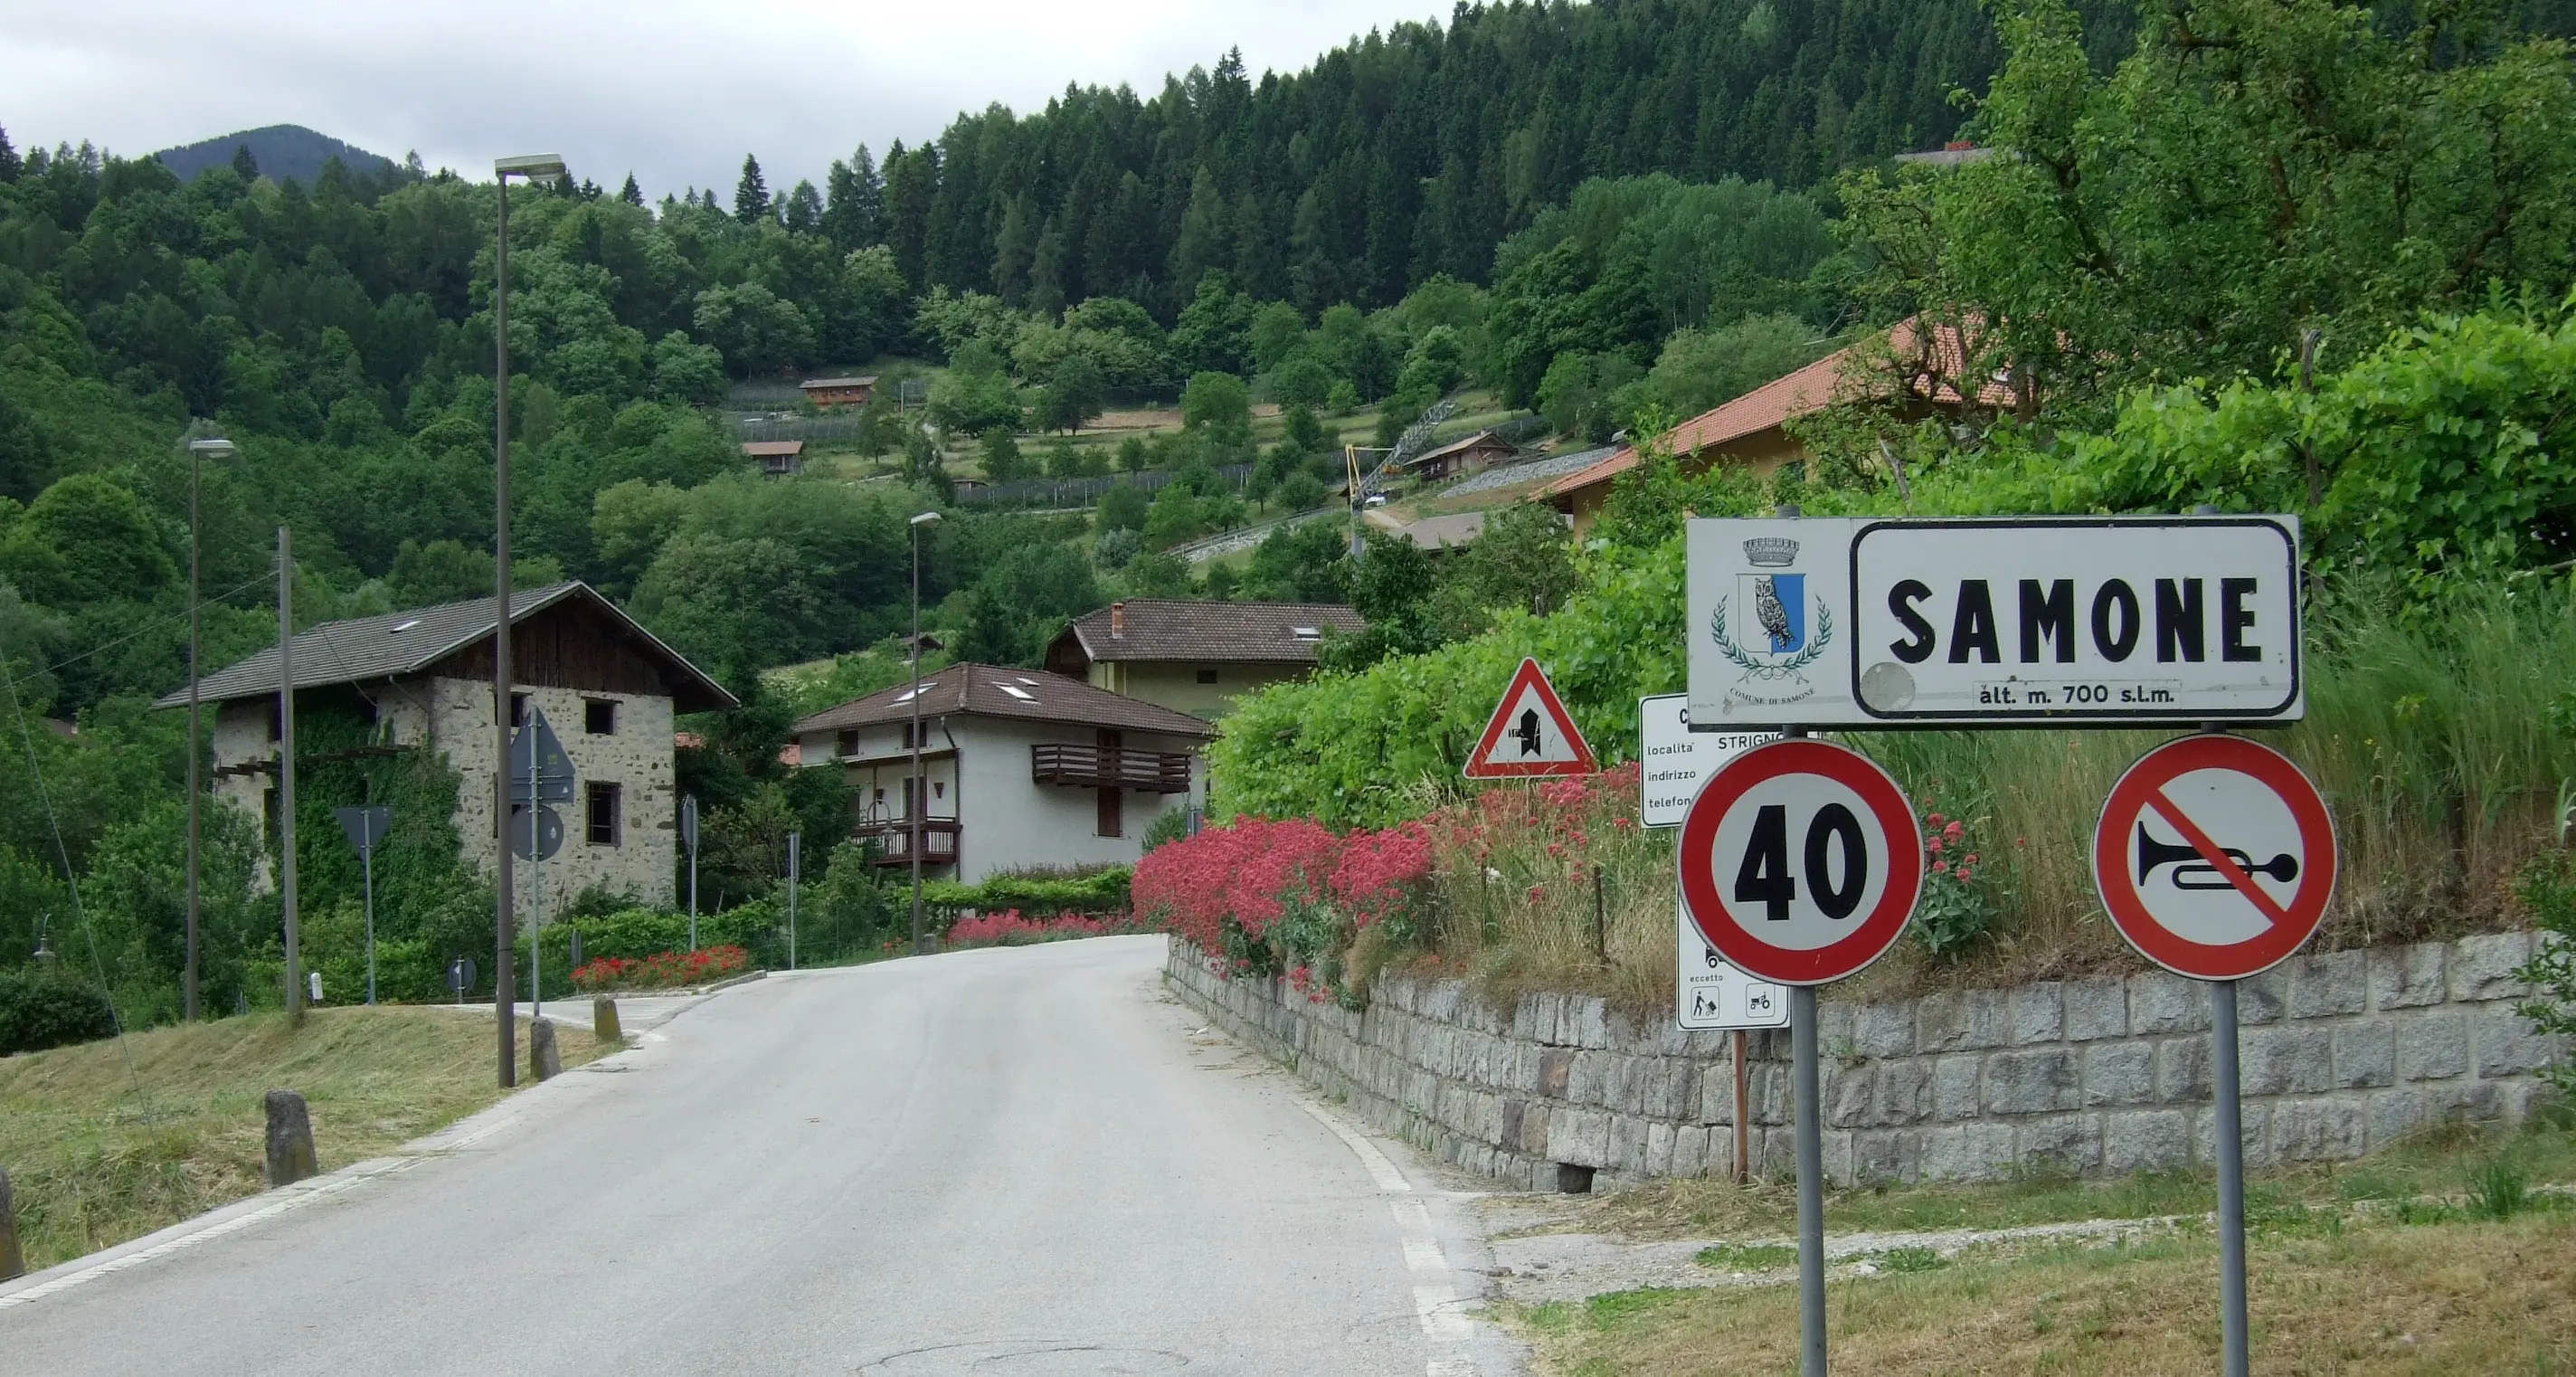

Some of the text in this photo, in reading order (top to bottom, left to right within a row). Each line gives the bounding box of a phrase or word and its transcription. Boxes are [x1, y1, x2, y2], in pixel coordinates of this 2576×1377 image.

[1888, 577, 2261, 664] SAMONE
[1729, 688, 1765, 705] COMUNE
[1781, 688, 1815, 705] SAMONE
[1980, 685, 2174, 704] alt. m. 700 s.l.m.
[1648, 769, 1696, 782] indirizzo
[1735, 802, 1868, 921] 40
[1690, 974, 1724, 983] eccetto
